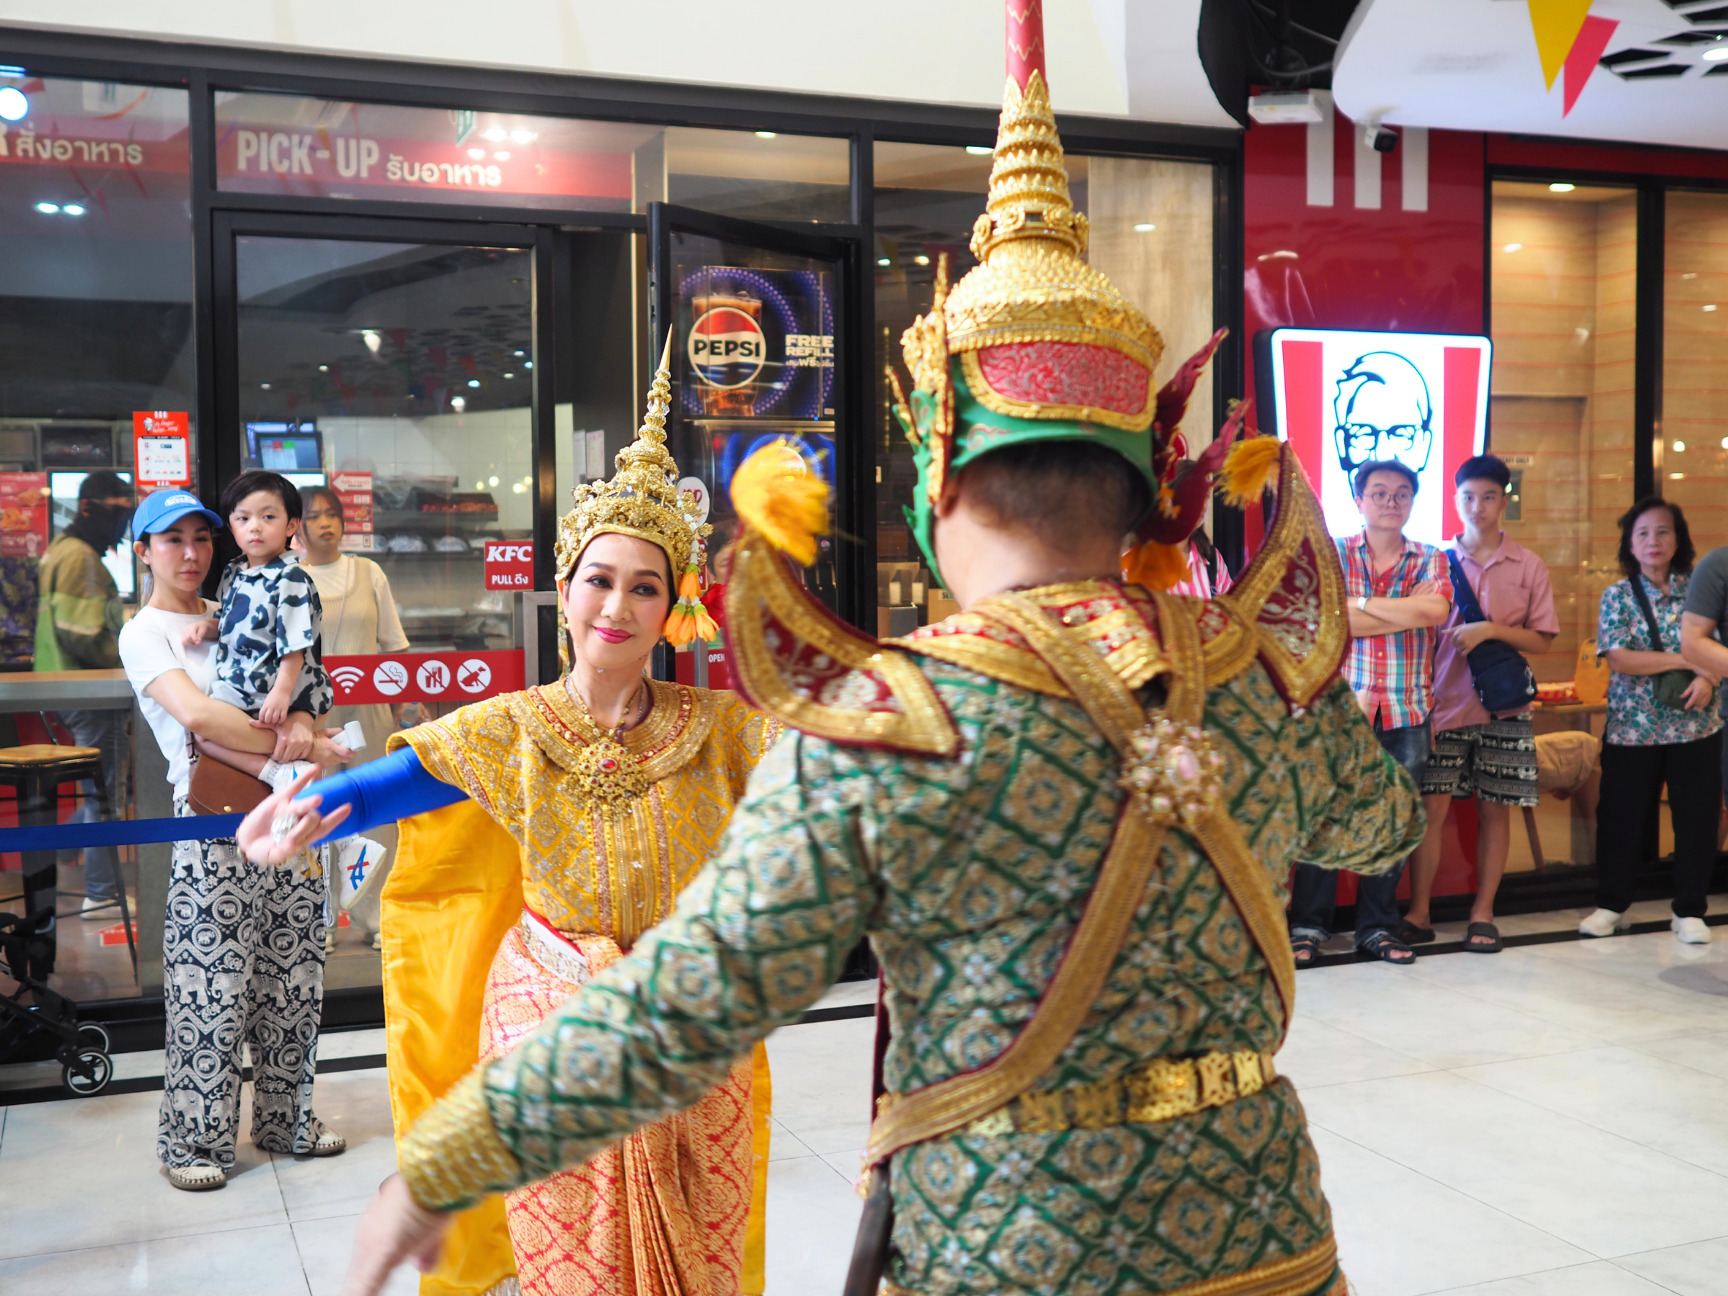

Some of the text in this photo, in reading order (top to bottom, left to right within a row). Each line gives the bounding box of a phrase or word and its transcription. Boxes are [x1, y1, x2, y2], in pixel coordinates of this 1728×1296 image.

[16, 121, 143, 165] สั่งอาหาร
[386, 153, 502, 187] รับอาหาร
[694, 339, 761, 357] PEPSI
[785, 335, 834, 348] FREE
[785, 347, 834, 357] REFILL
[486, 545, 532, 562] KFC
[491, 574, 513, 585] PULL
